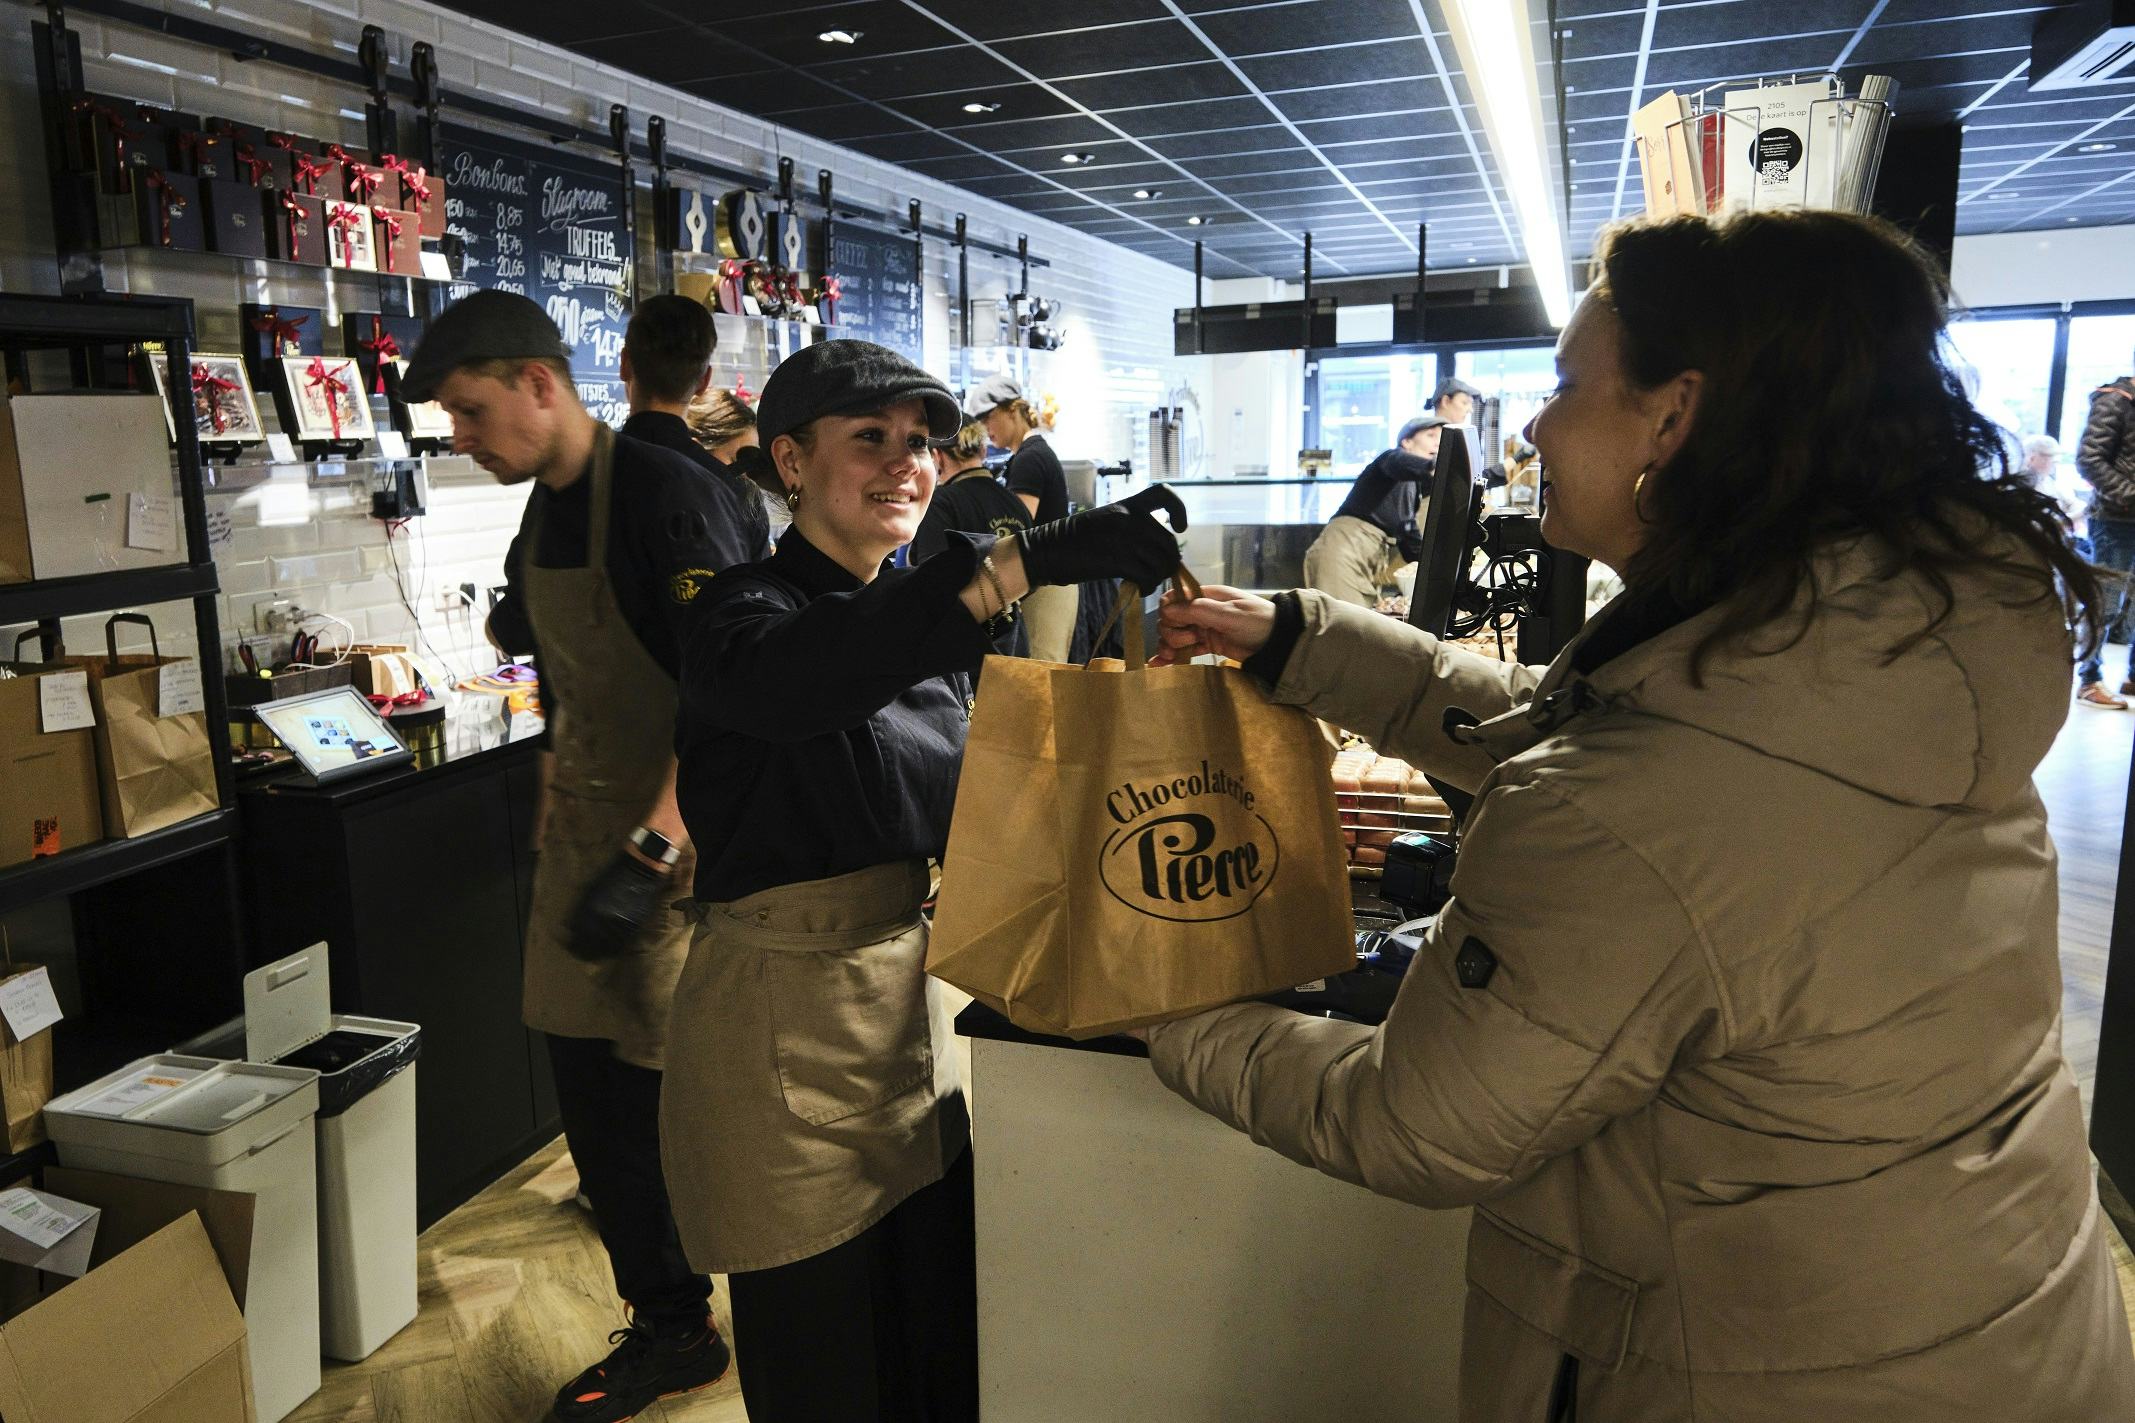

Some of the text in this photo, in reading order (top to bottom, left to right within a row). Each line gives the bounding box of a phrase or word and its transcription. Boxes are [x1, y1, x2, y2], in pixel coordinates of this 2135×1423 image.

[1766, 111, 1787, 119] kaart
[1796, 109, 1807, 117] op
[1767, 101, 1785, 110] 2105
[445, 198, 464, 219] 150
[1105, 759, 1256, 825] Chocolaterie
[1111, 812, 1264, 904] Pierre
